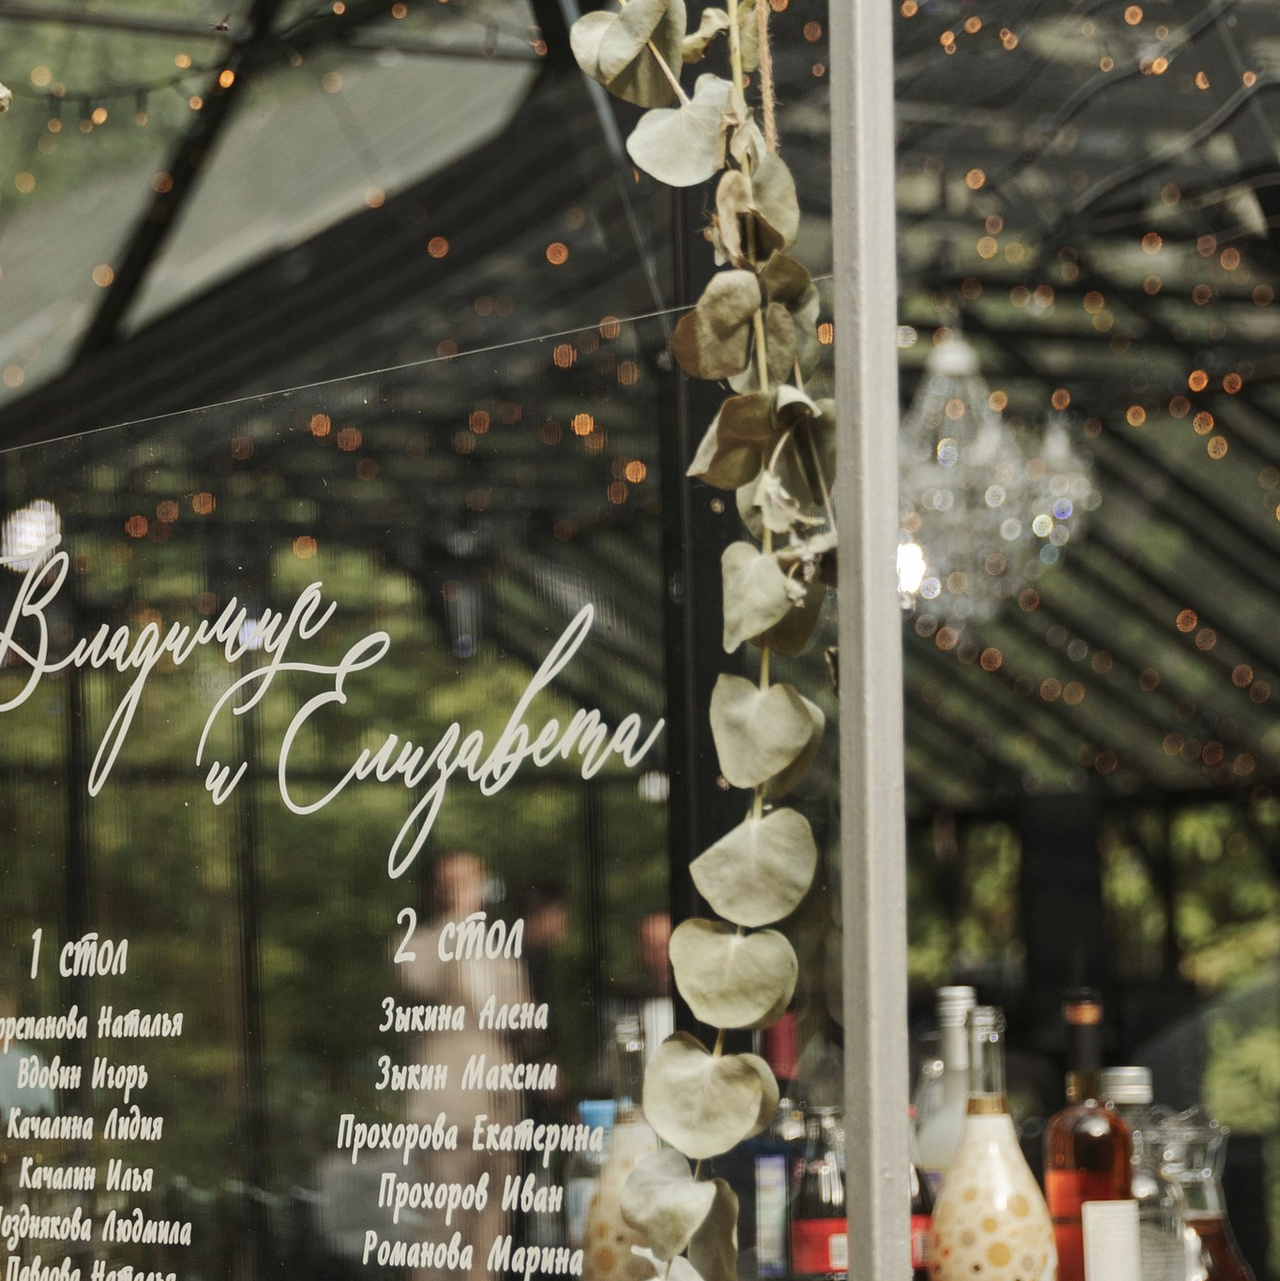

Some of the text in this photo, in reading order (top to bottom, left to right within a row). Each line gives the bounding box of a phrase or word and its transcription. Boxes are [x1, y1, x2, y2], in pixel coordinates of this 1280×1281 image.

[195, 602, 665, 880] и Елизавета
[31, 928, 129, 979] 1 стол
[393, 907, 525, 964] 2 стол
[98, 1006, 183, 1038] Наталья
[379, 994, 549, 1032] Зыкина Алена
[17, 1055, 148, 1104] Вдовин Игорь
[375, 1054, 558, 1091] Зыкин Максим
[7, 1105, 163, 1141] Качалина Лидия
[337, 1112, 604, 1169] Прохорова Екатерина
[19, 1156, 153, 1192] Качалин Илья
[378, 1172, 564, 1226] Прохоров Иван
[102, 1208, 192, 1246] Людмила
[362, 1230, 473, 1271] Романова
